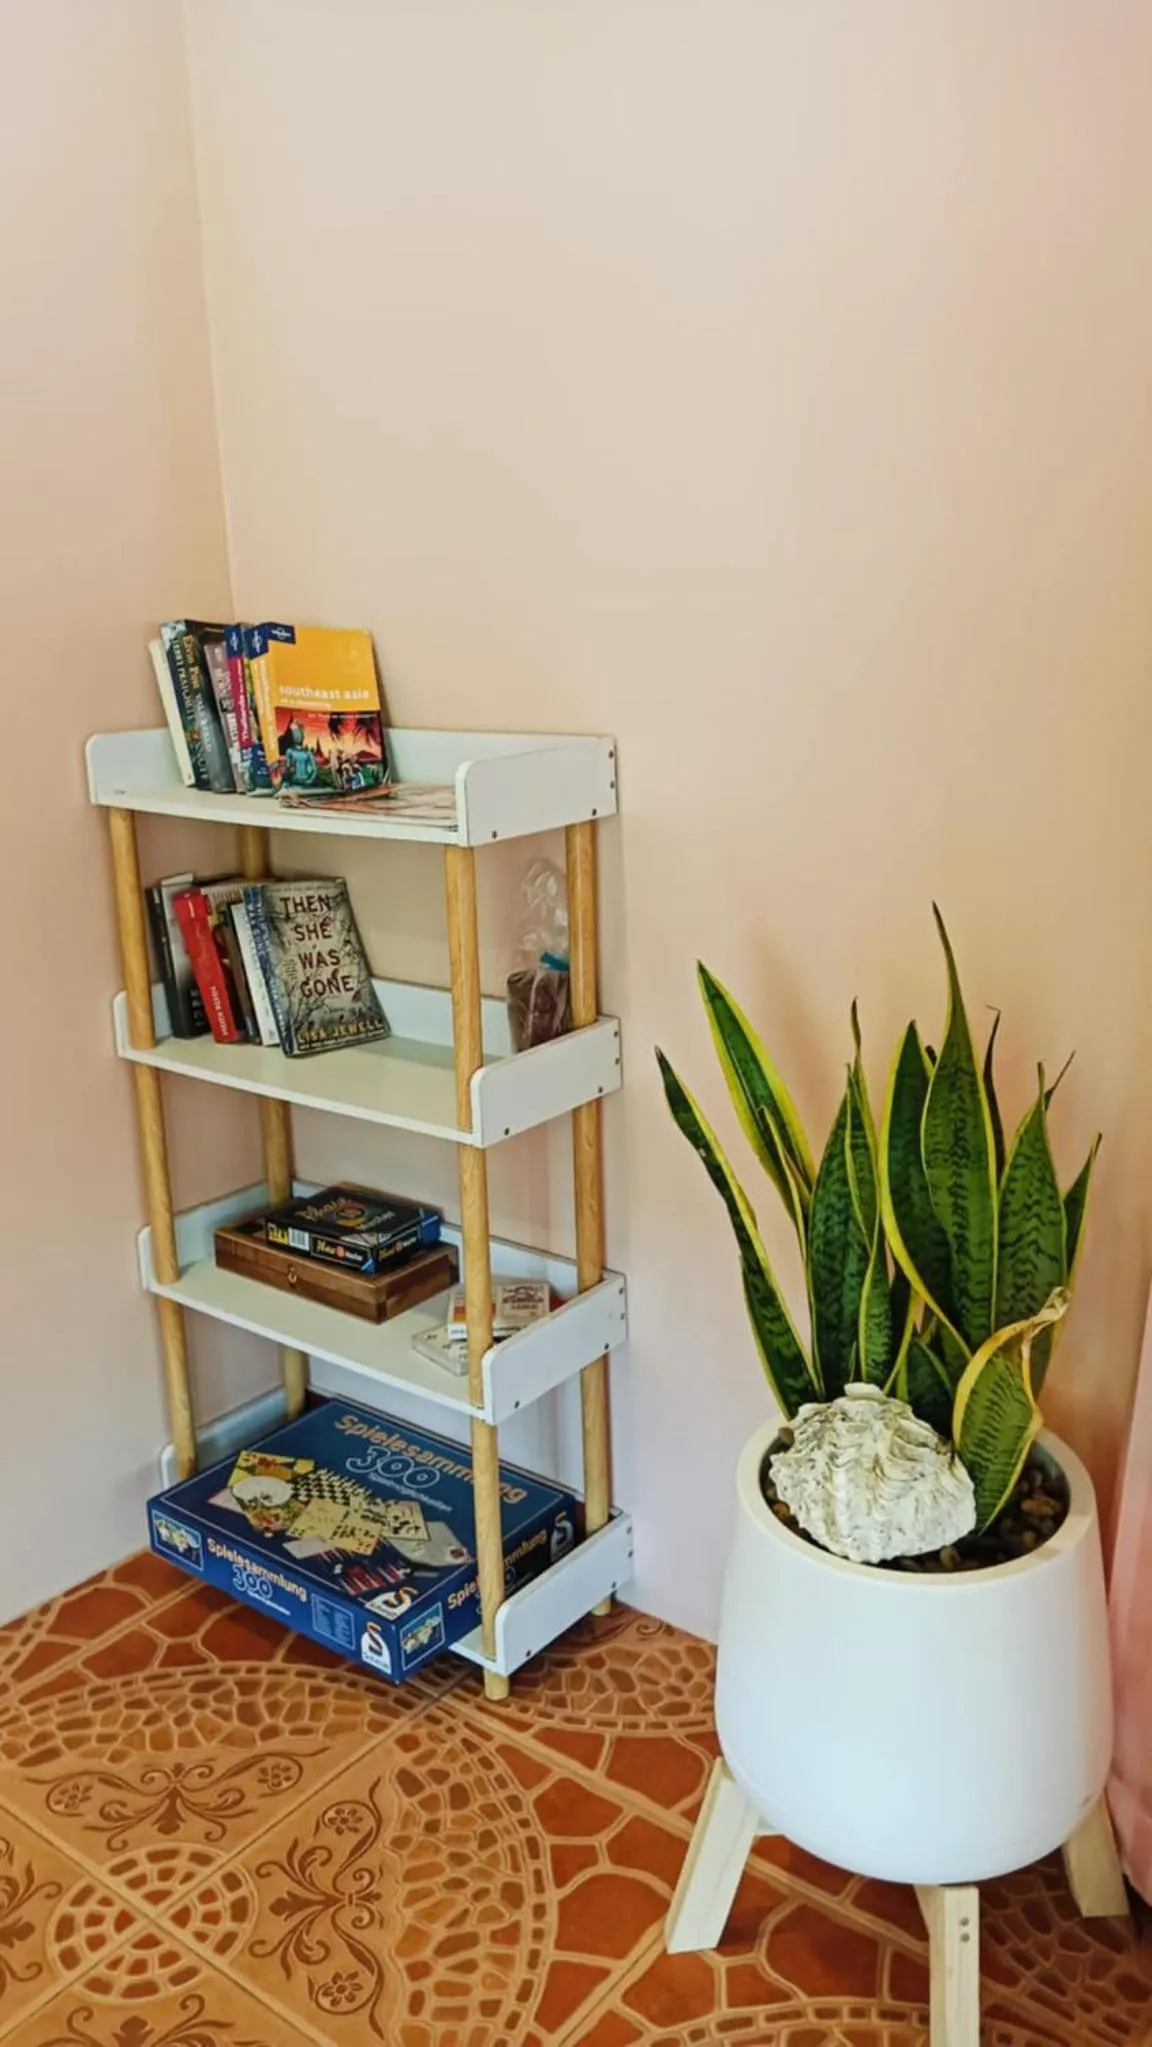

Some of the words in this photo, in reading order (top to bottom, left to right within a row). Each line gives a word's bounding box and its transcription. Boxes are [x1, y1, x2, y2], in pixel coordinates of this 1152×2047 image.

[279, 685, 341, 700] southeast
[343, 688, 371, 700] asia
[279, 893, 331, 920] THEN
[294, 917, 332, 941] SHE
[298, 950, 341, 971] WAS
[300, 974, 355, 999] GONE
[298, 1026, 326, 1045] LISA
[326, 1018, 384, 1040] JEWELL
[346, 1446, 441, 1489] 300
[206, 1538, 307, 1603] Spielesammlung
[232, 1564, 273, 1600] 300
